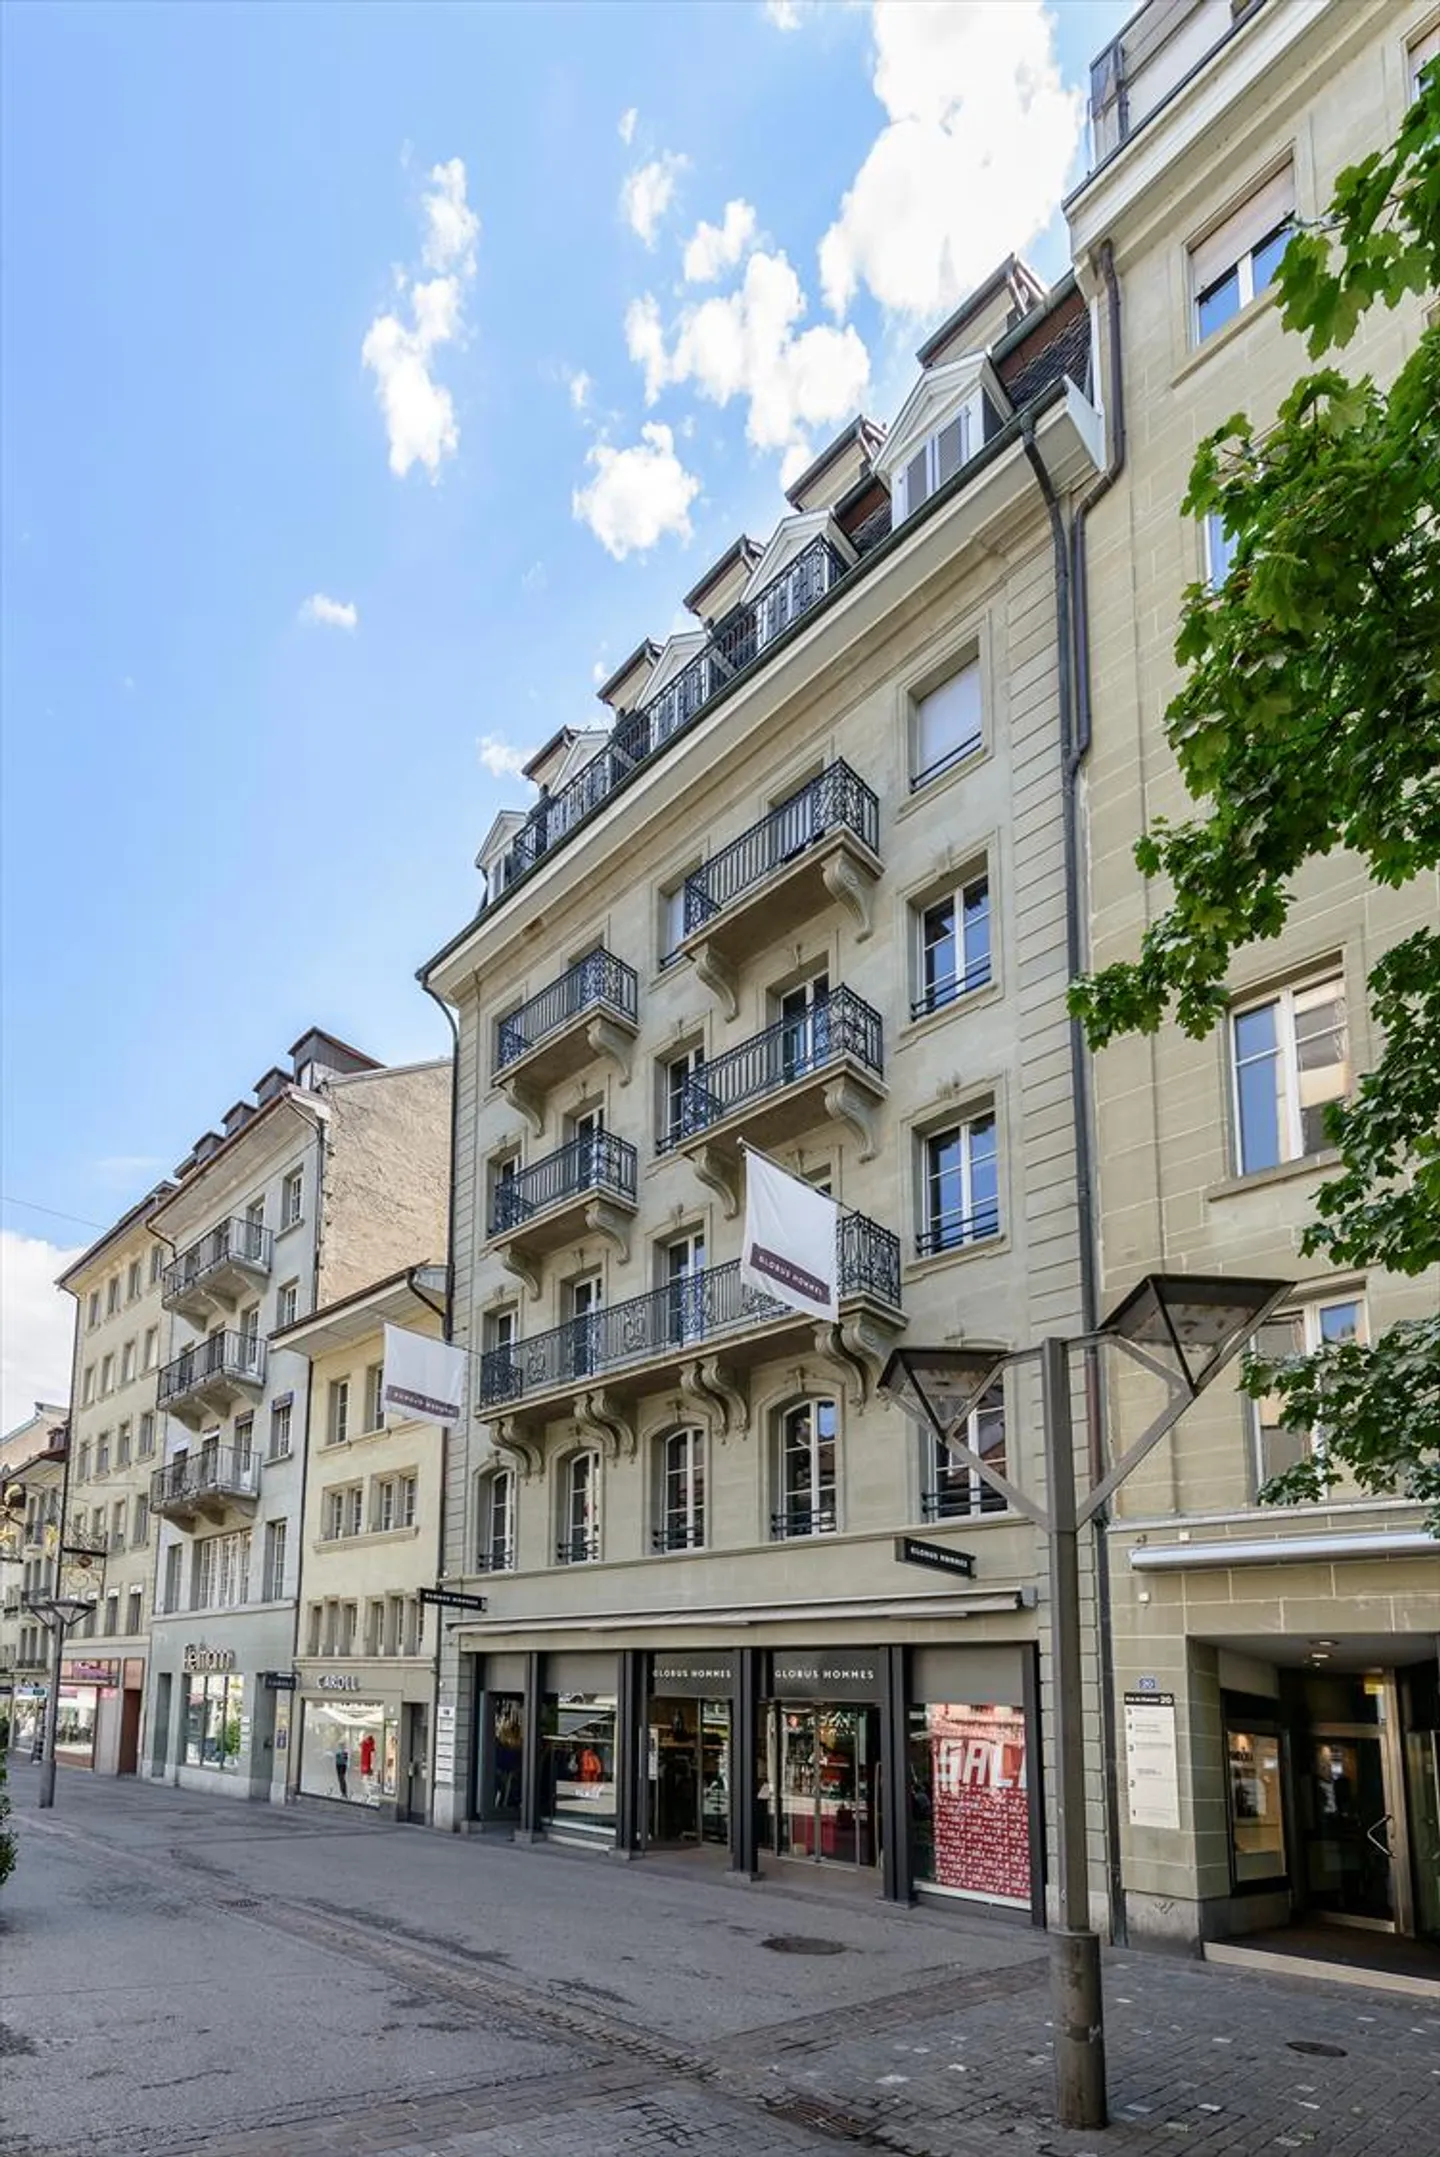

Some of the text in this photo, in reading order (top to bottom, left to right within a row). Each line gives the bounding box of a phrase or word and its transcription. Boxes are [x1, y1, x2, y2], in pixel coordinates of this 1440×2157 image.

[653, 1669, 731, 1678] GLOBUS HOMMES
[775, 1670, 874, 1679] GLOBUS HOMMES
[317, 1675, 359, 1690] CAROLL
[1160, 1695, 1172, 1704] 20
